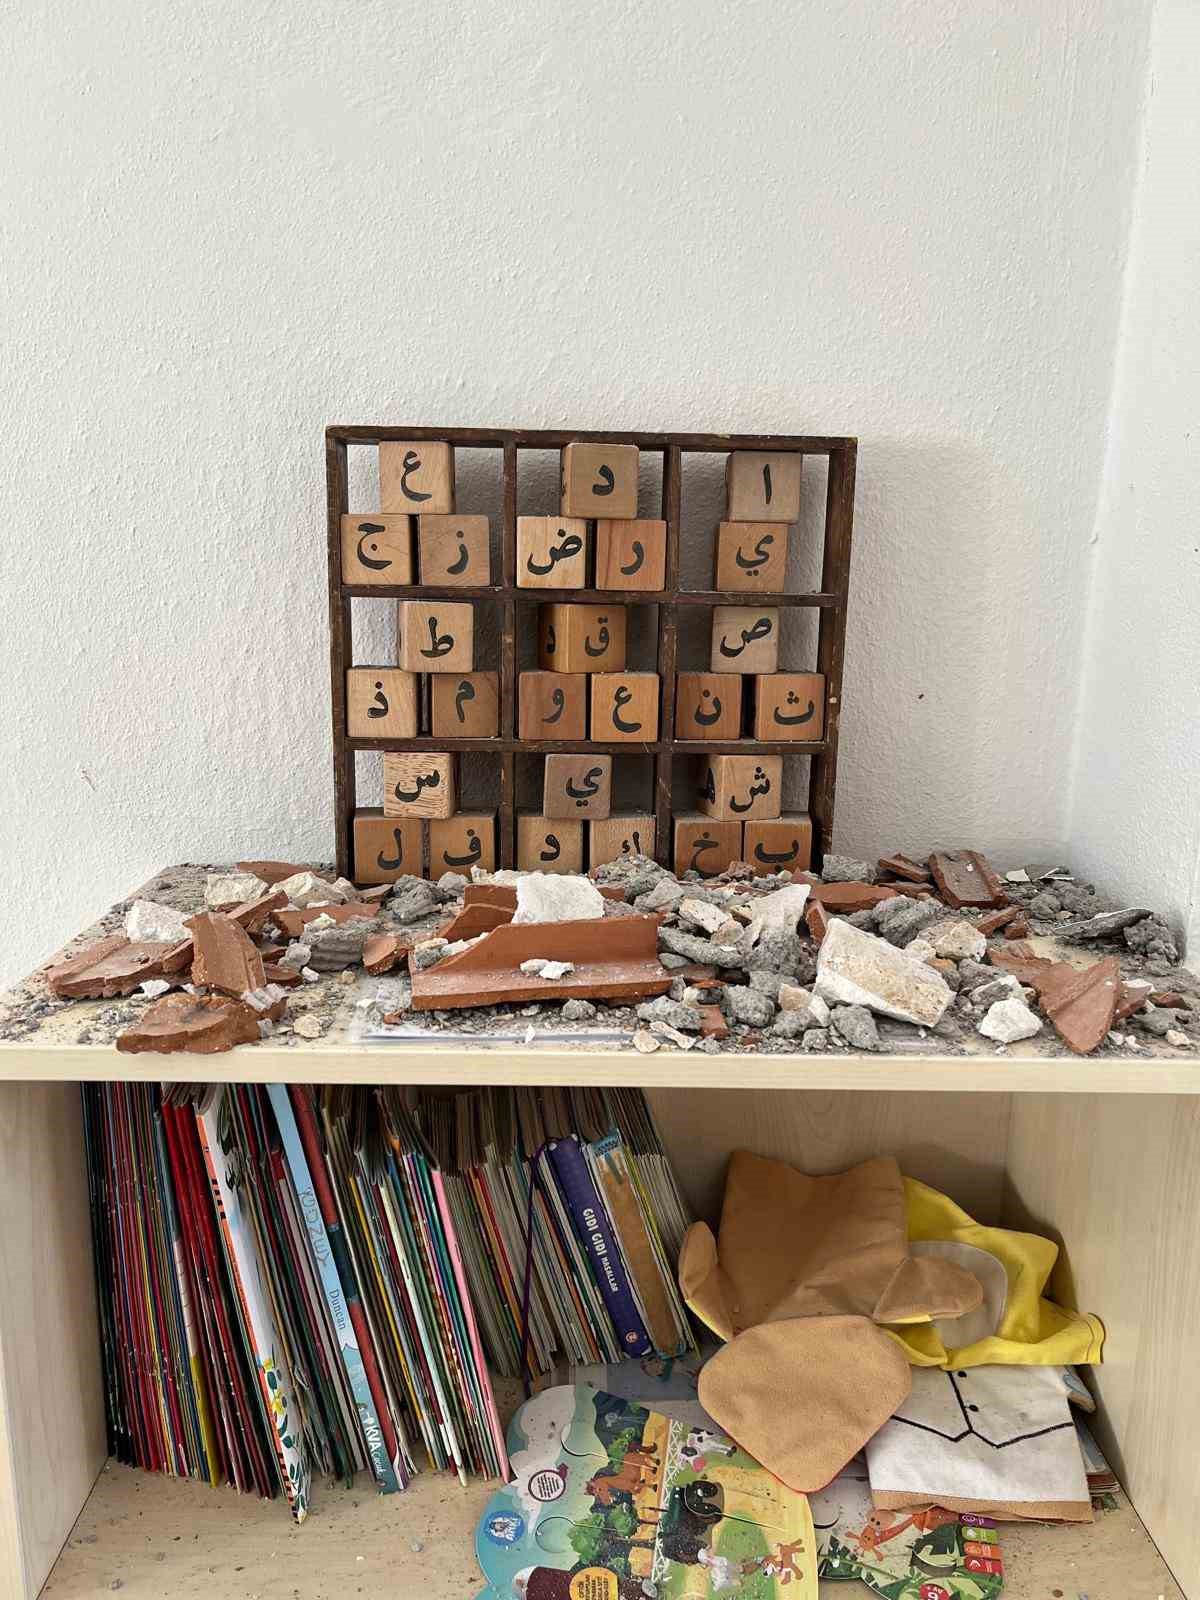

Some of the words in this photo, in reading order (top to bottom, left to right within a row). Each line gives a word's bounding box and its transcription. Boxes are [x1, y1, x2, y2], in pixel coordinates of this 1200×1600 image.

[401, 451, 432, 502] ع
[592, 465, 614, 496] د
[763, 464, 771, 504] ا
[357, 523, 392, 570] ج
[447, 531, 468, 575] ز
[527, 529, 582, 575] ض
[621, 541, 644, 575] ر
[736, 535, 773, 576] ي
[421, 617, 454, 658] ط
[585, 616, 609, 657] ق
[719, 616, 773, 657] ص
[368, 682, 388, 718] ذ
[456, 680, 475, 723] م
[542, 689, 564, 723] و
[613, 686, 641, 733] ع
[694, 690, 721, 726] ن
[774, 691, 814, 725] ث
[395, 770, 441, 802] س
[566, 768, 602, 807] ي
[730, 767, 770, 812] ش
[378, 828, 402, 870] ل
[443, 829, 483, 868] ف
[541, 834, 560, 861] د
[691, 832, 720, 876] خ
[755, 840, 799, 871] ب
[328, 1288, 346, 1330] Duncan
